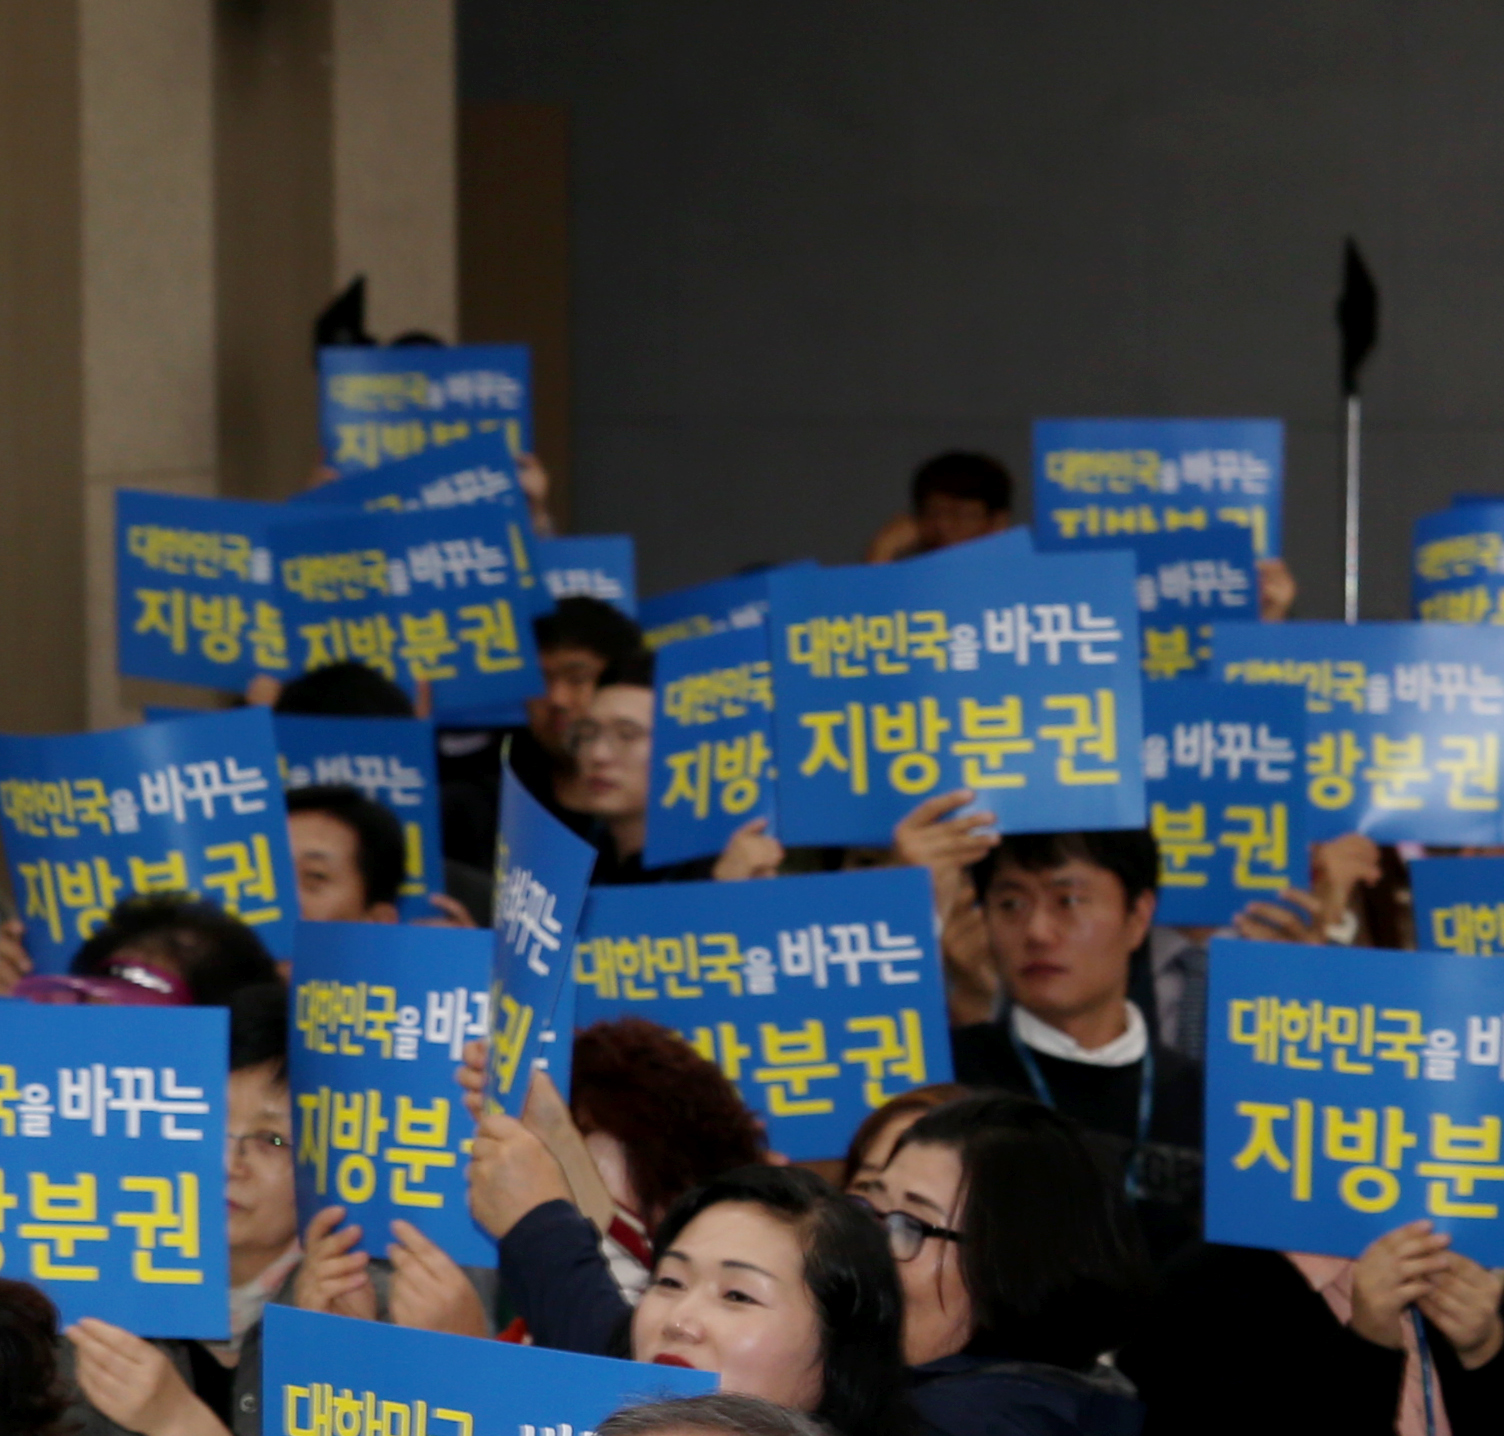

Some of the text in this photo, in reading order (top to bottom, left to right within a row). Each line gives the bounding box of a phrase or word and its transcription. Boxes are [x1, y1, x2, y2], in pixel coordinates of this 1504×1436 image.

[127, 524, 273, 584] 대한민국을
[407, 538, 507, 590] 바꾸는
[134, 588, 288, 670] 지방분
[298, 600, 522, 682] 지방분권
[786, 609, 980, 679] 대한민국을
[984, 603, 1123, 668] 바꾸는
[663, 661, 775, 726] 대한민국
[1394, 660, 1504, 715] 바꾸는
[661, 730, 778, 818] 지방
[799, 688, 1120, 795] 지방분권
[1173, 720, 1295, 782] 바꾸는
[1305, 730, 1498, 811] 방분권
[140, 756, 269, 822] 바꾸는
[1150, 803, 1290, 889] 분권
[572, 921, 922, 1001] 대한민국을 바꾸는
[295, 980, 422, 1061] 대한민국을
[1228, 996, 1460, 1081] 대한민국을
[58, 1063, 210, 1141] 바꾸는
[297, 1087, 472, 1209] 지방분
[1232, 1098, 1504, 1219] 지방분
